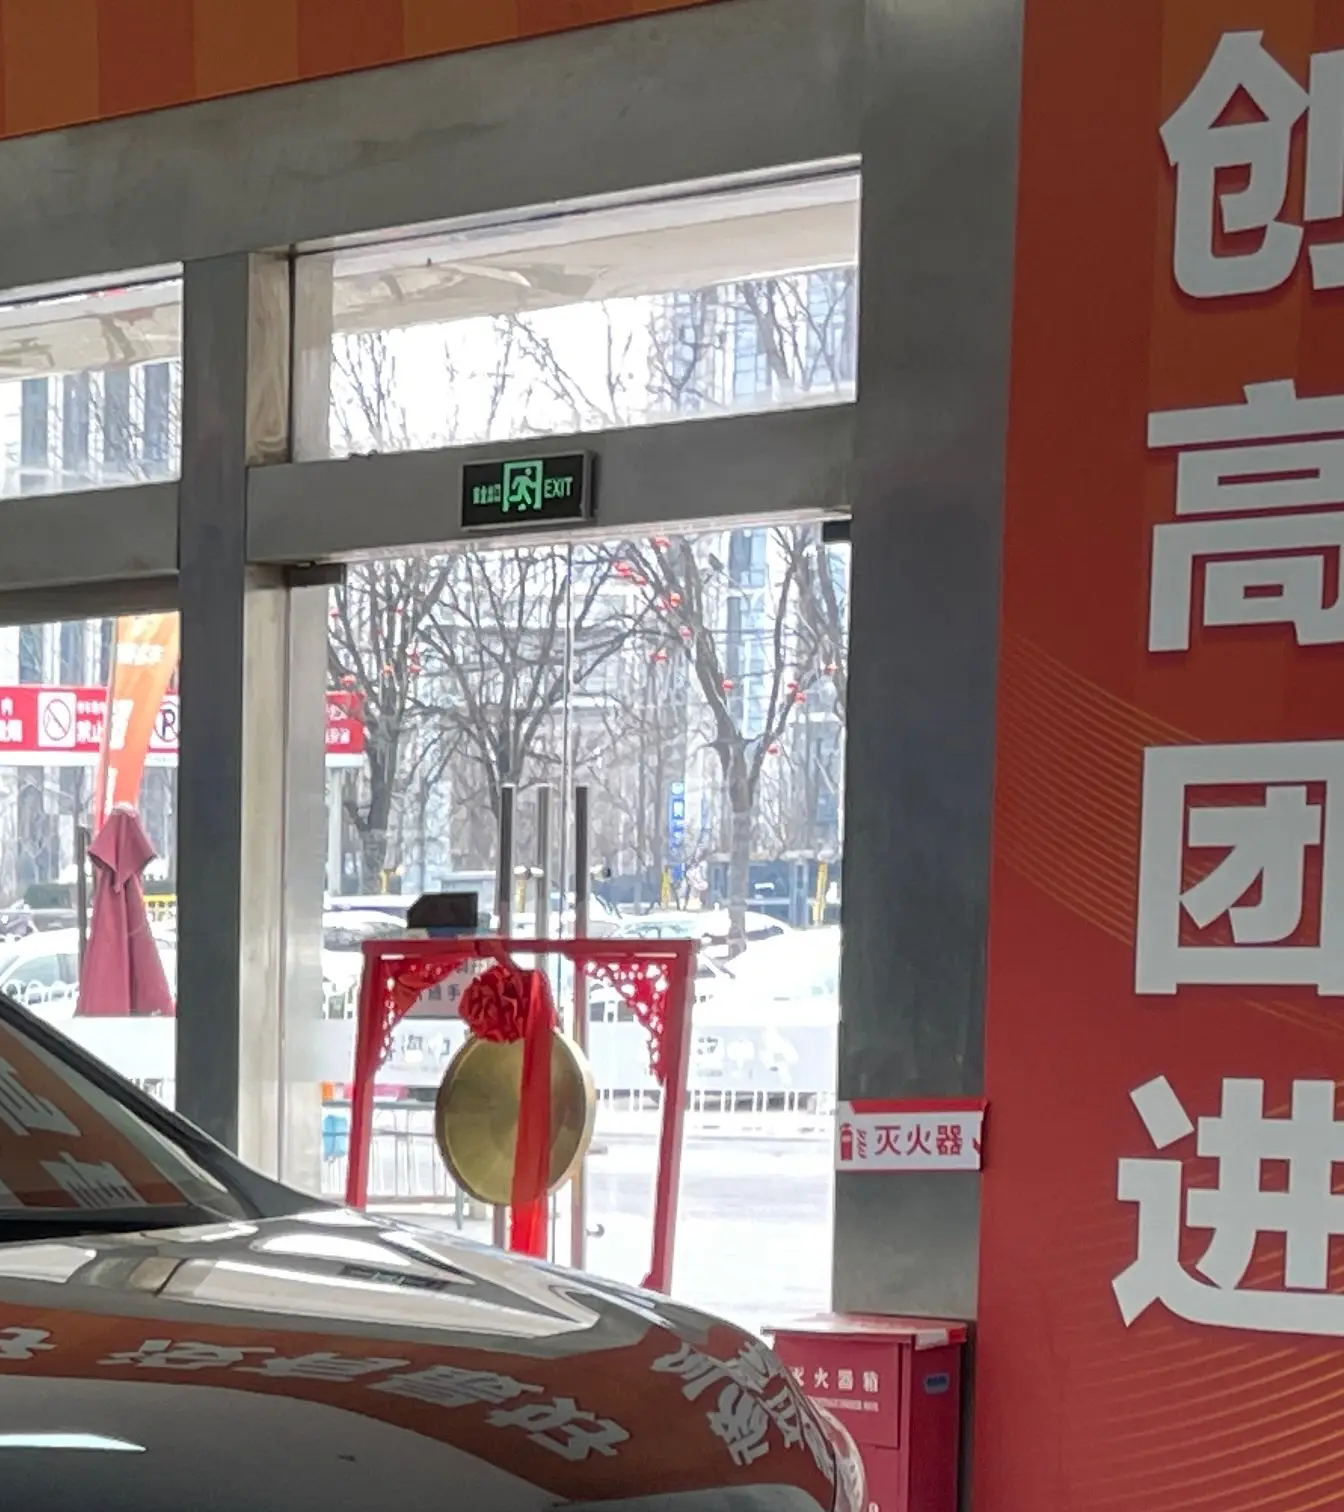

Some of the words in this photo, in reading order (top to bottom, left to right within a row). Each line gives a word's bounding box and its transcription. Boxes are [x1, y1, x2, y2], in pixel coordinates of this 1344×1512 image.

[543, 476, 574, 499] EXIT
[1147, 379, 1344, 652] 高
[1135, 739, 1344, 998] 团
[874, 1123, 962, 1156] 灭火器
[1112, 1074, 1344, 1336] 进
